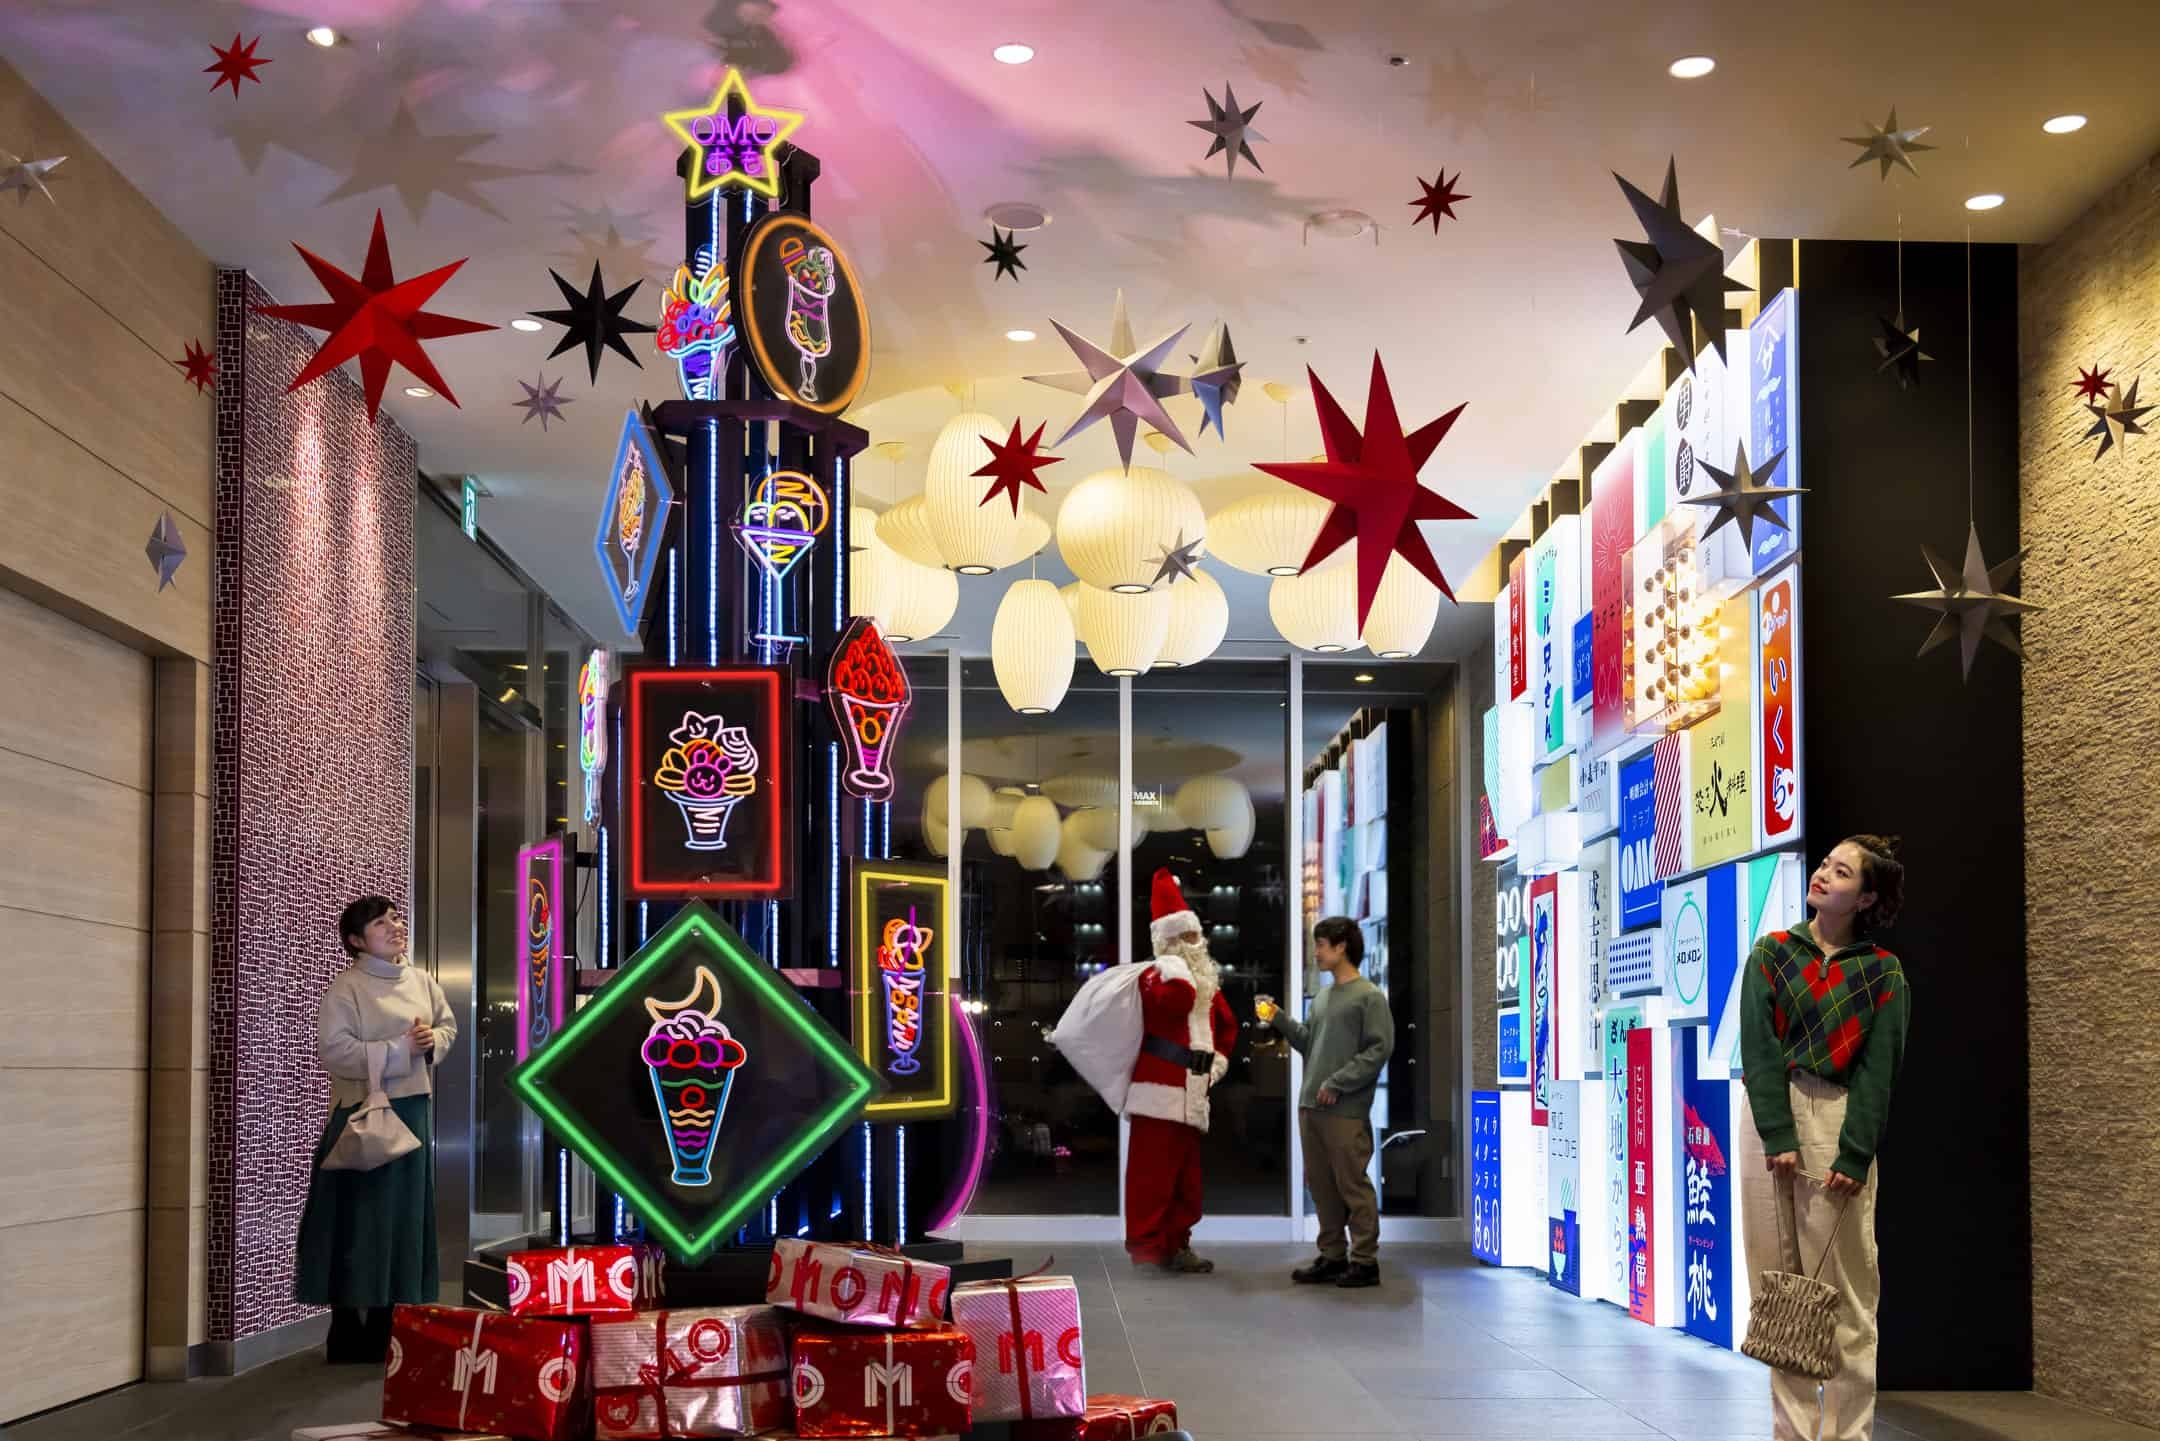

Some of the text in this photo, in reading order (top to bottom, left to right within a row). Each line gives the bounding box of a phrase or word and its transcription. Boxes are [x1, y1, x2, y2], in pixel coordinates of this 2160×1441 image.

[692, 115, 777, 144] OMO
[706, 147, 762, 175] おも
[1769, 657, 1787, 811] いくら
[1687, 1156, 1716, 1225] 鮭
[1687, 1249, 1717, 1321] 桃
